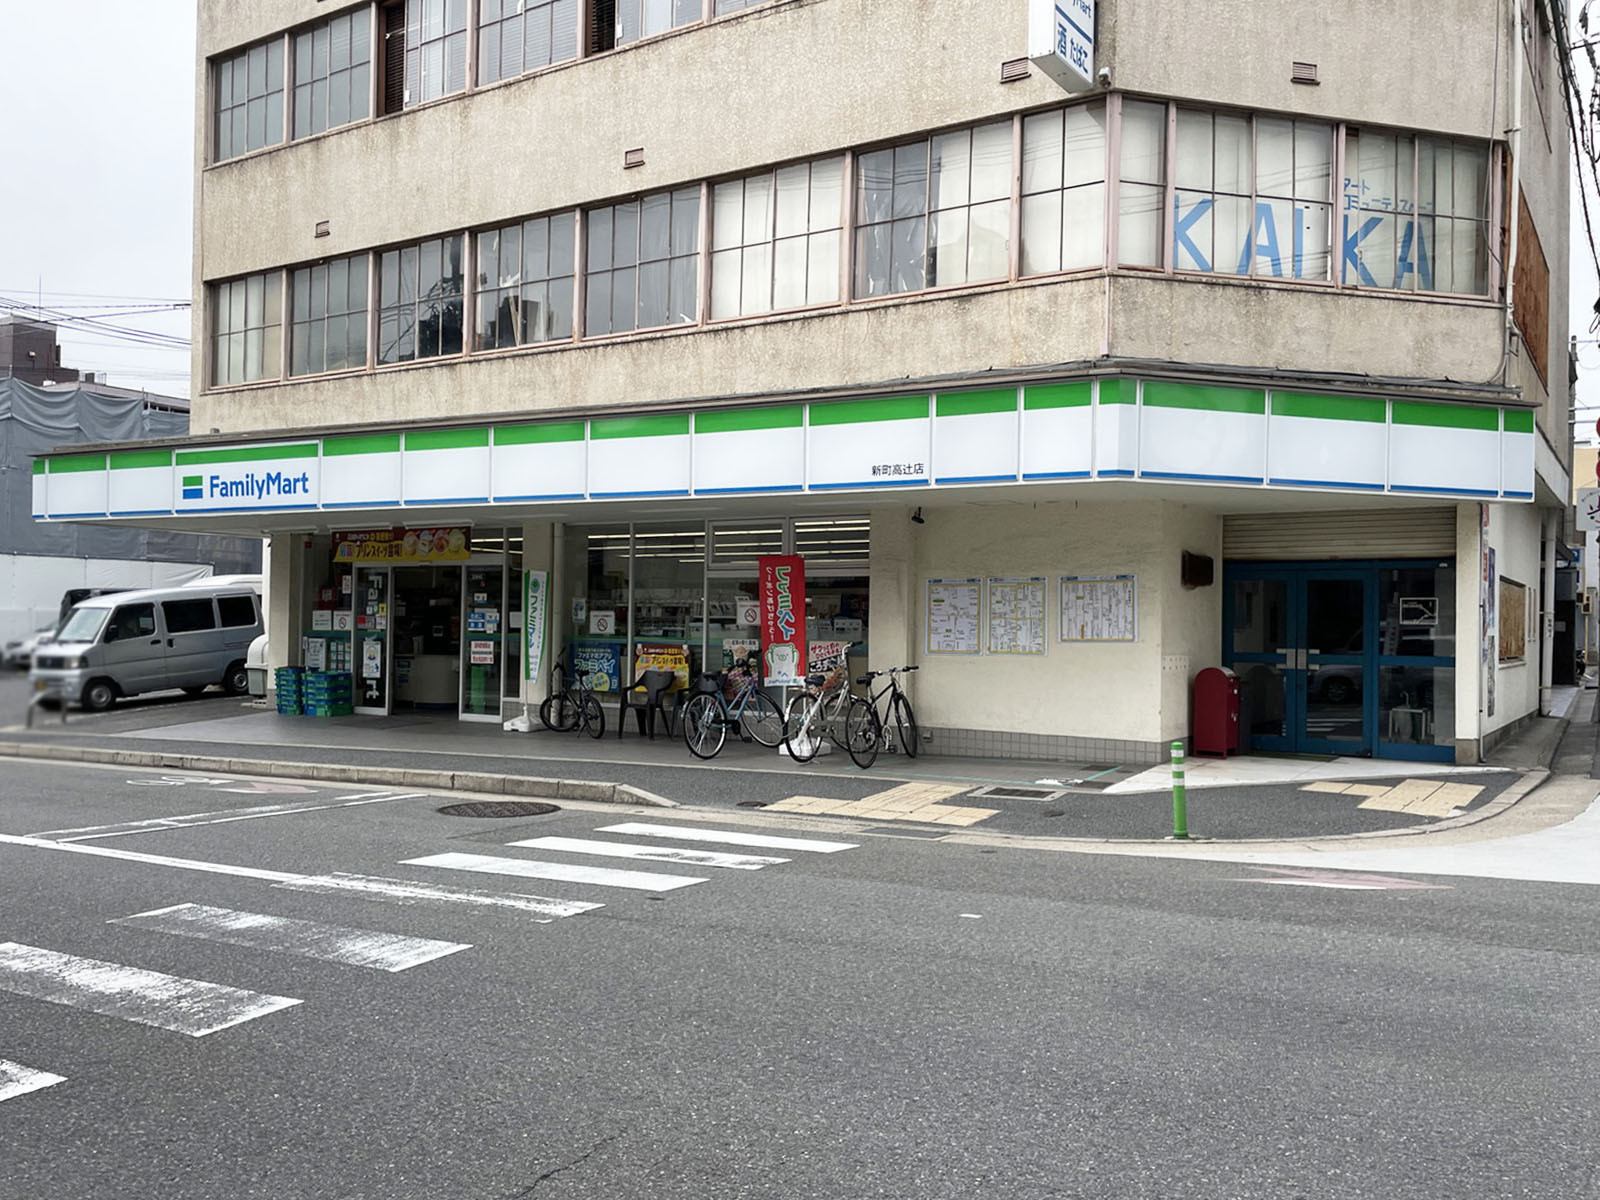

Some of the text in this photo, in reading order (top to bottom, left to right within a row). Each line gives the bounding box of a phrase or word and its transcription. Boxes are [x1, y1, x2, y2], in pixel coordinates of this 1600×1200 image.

[1058, 22, 1088, 74] 酒 たばこ
[872, 463, 924, 476] 新町高辻店
[209, 472, 309, 500] FamilyMart
[574, 659, 615, 673] ファミペイ
